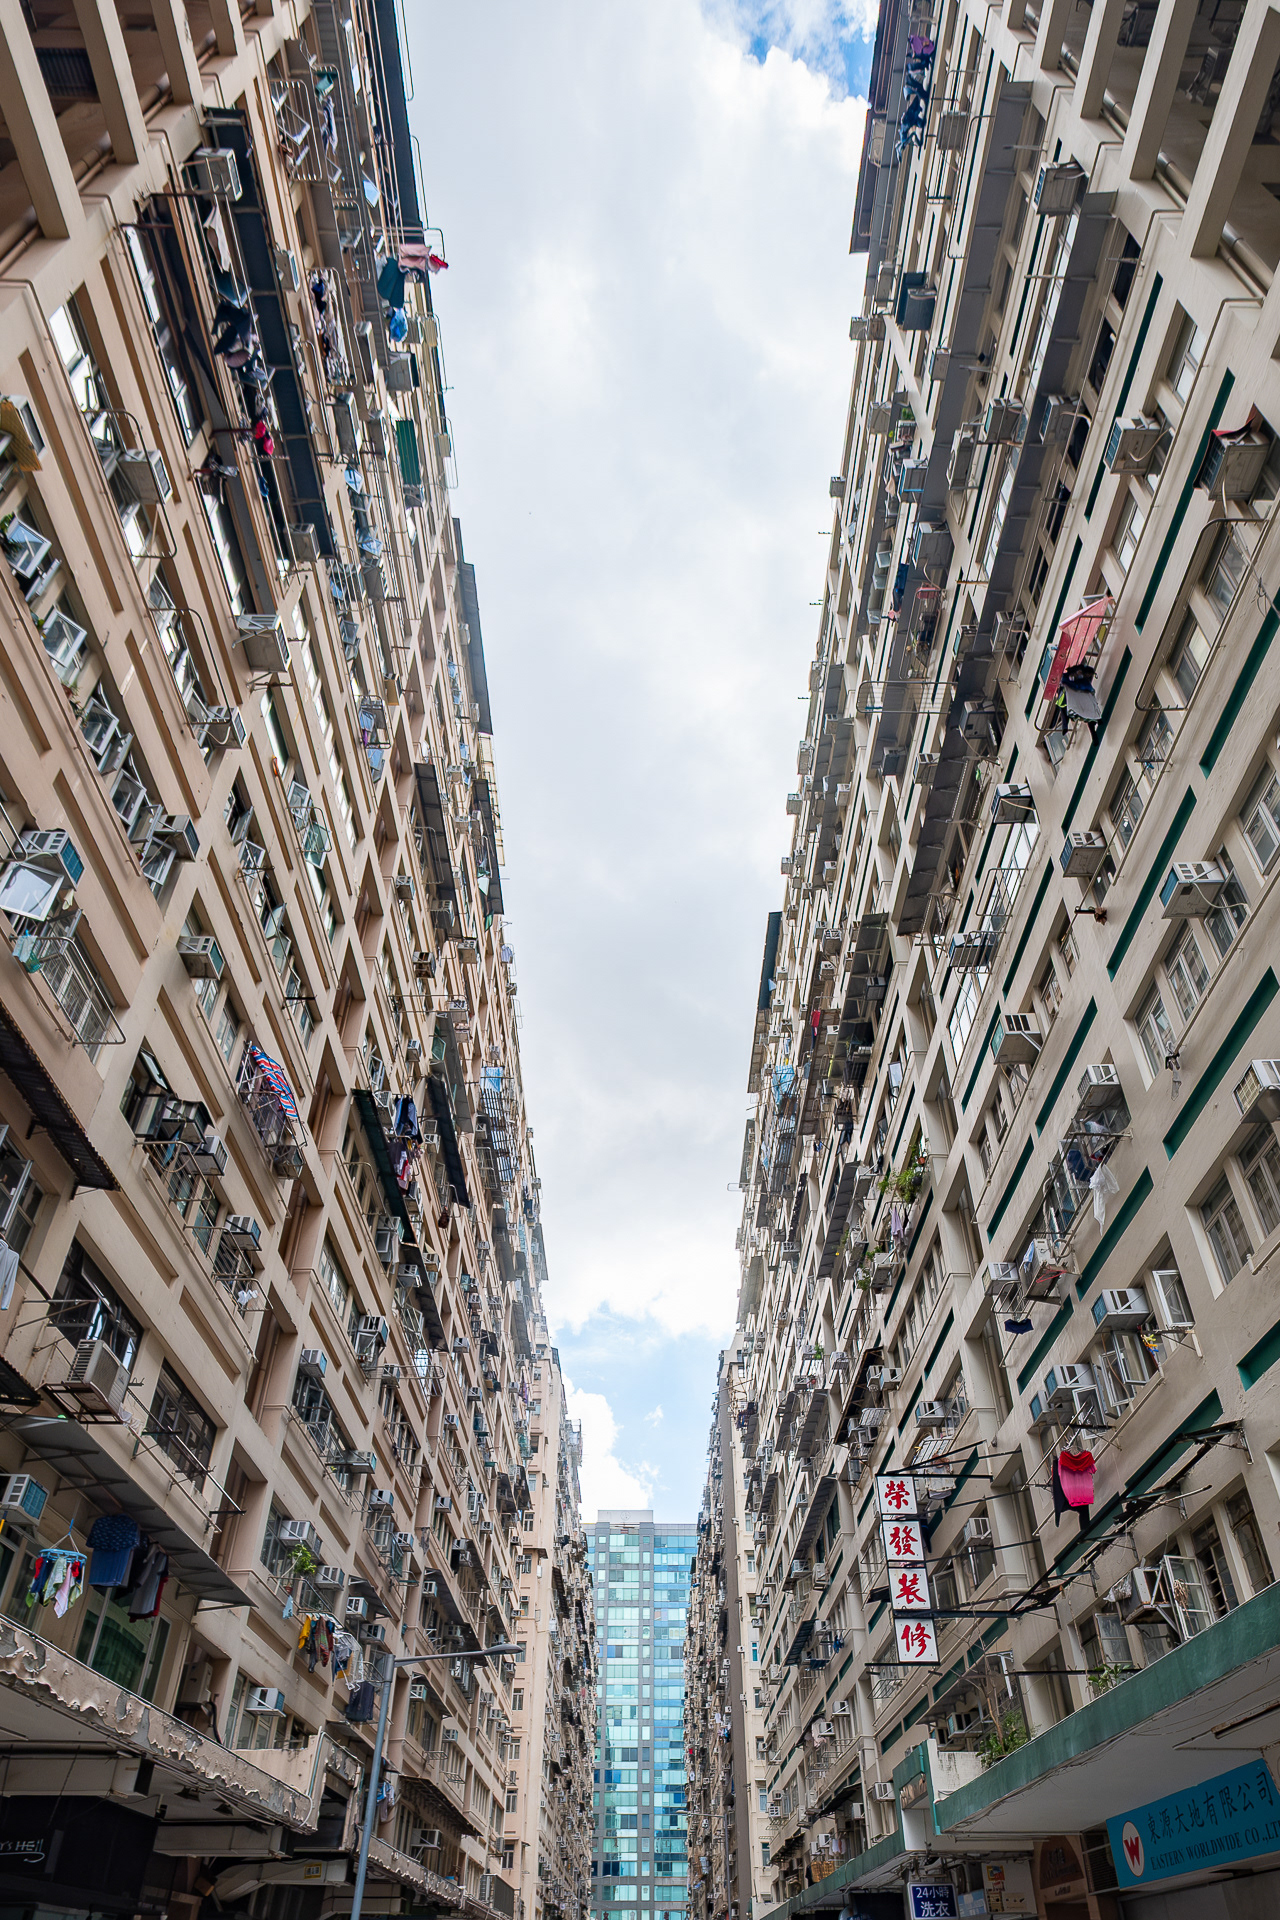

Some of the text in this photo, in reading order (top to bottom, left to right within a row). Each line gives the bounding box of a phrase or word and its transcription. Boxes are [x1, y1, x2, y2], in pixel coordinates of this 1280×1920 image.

[884, 1480, 931, 1657] 榮發裝修
[1147, 1771, 1274, 1844] 東源大地有限公司
[1150, 1820, 1280, 1871] EASTERN WORLDWIDE CO.,LT
[915, 1886, 950, 1899] 24小時
[920, 1900, 951, 1917] 洗衣
